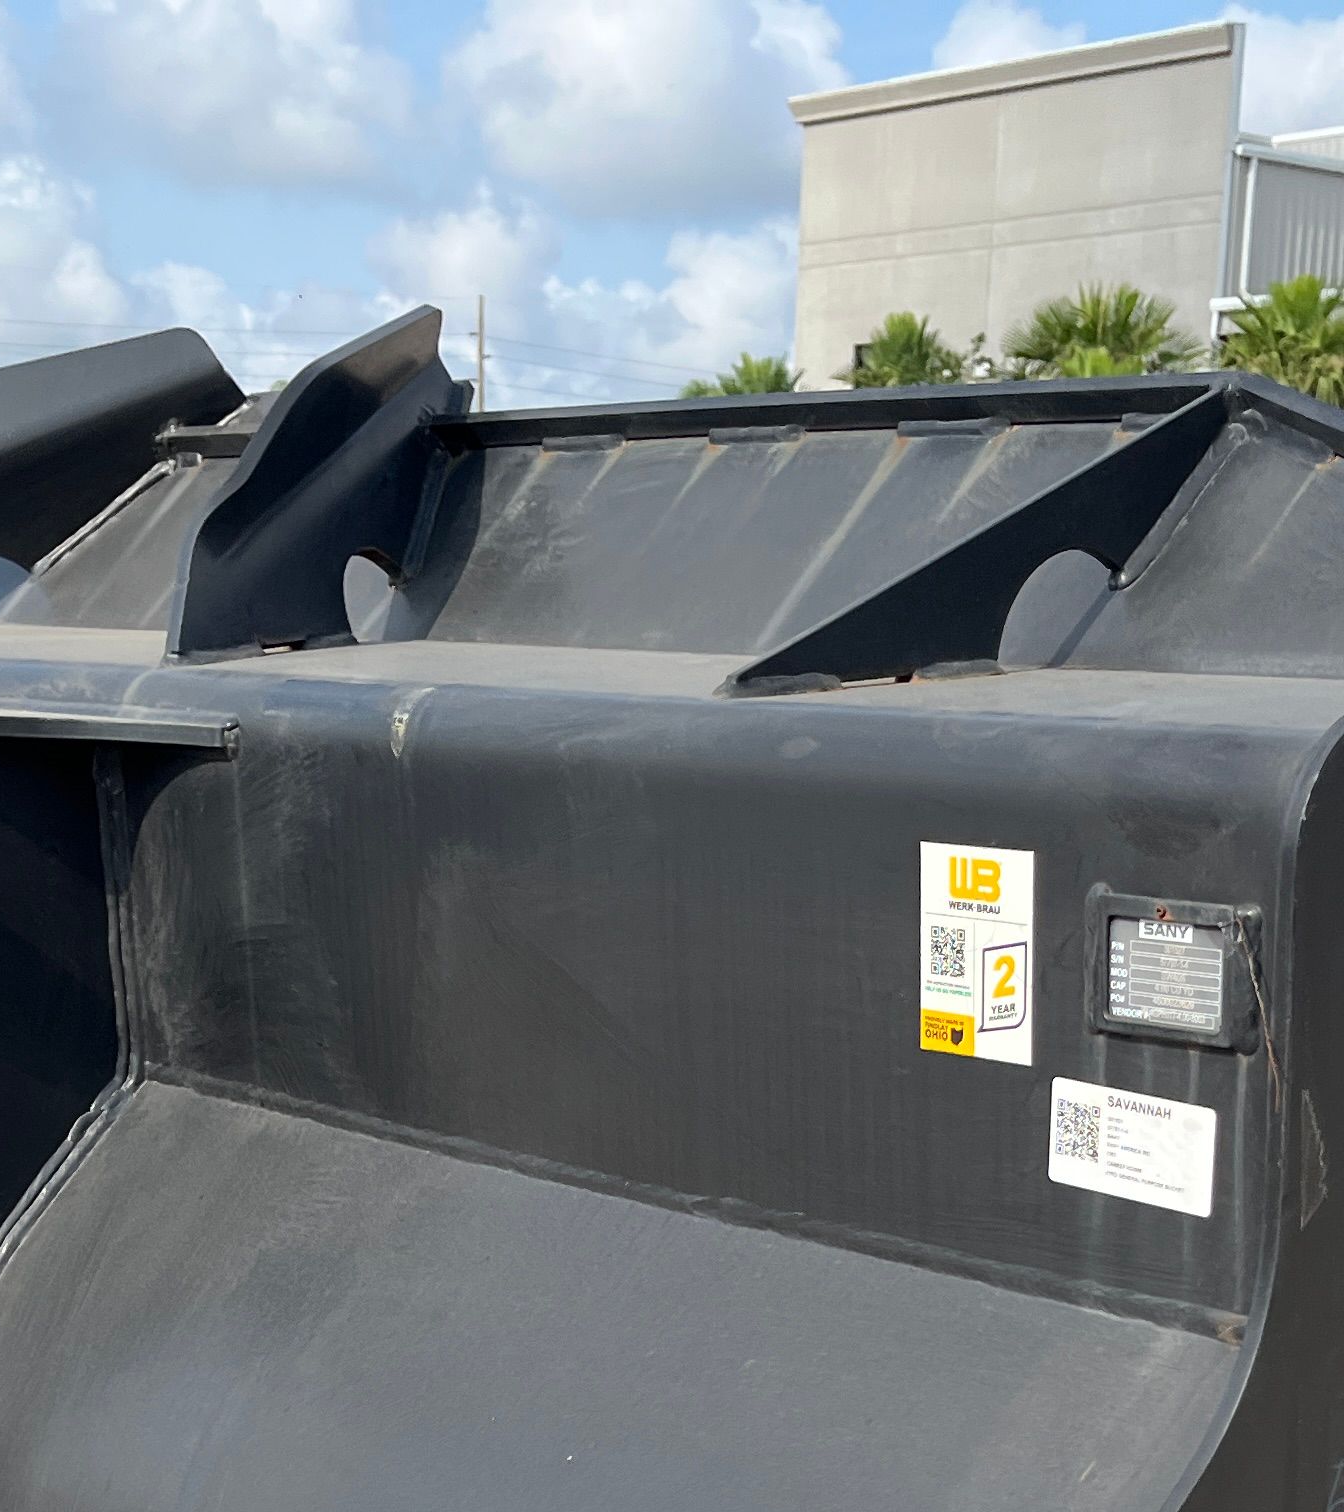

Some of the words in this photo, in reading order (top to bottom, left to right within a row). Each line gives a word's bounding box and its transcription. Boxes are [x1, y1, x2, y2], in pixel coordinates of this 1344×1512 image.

[949, 856, 1001, 902] WB
[948, 901, 1001, 915] WERK-BRAU
[1143, 922, 1190, 939] SANY
[1110, 954, 1124, 964] S/N
[993, 955, 1015, 998] 2
[1110, 968, 1128, 978] MOD
[1110, 980, 1126, 990] CAP
[991, 1003, 1016, 1014] YEAR
[1111, 1006, 1143, 1019] VENDOR
[925, 1028, 948, 1041] OHIO
[1107, 1095, 1172, 1120] SAVANNAH
